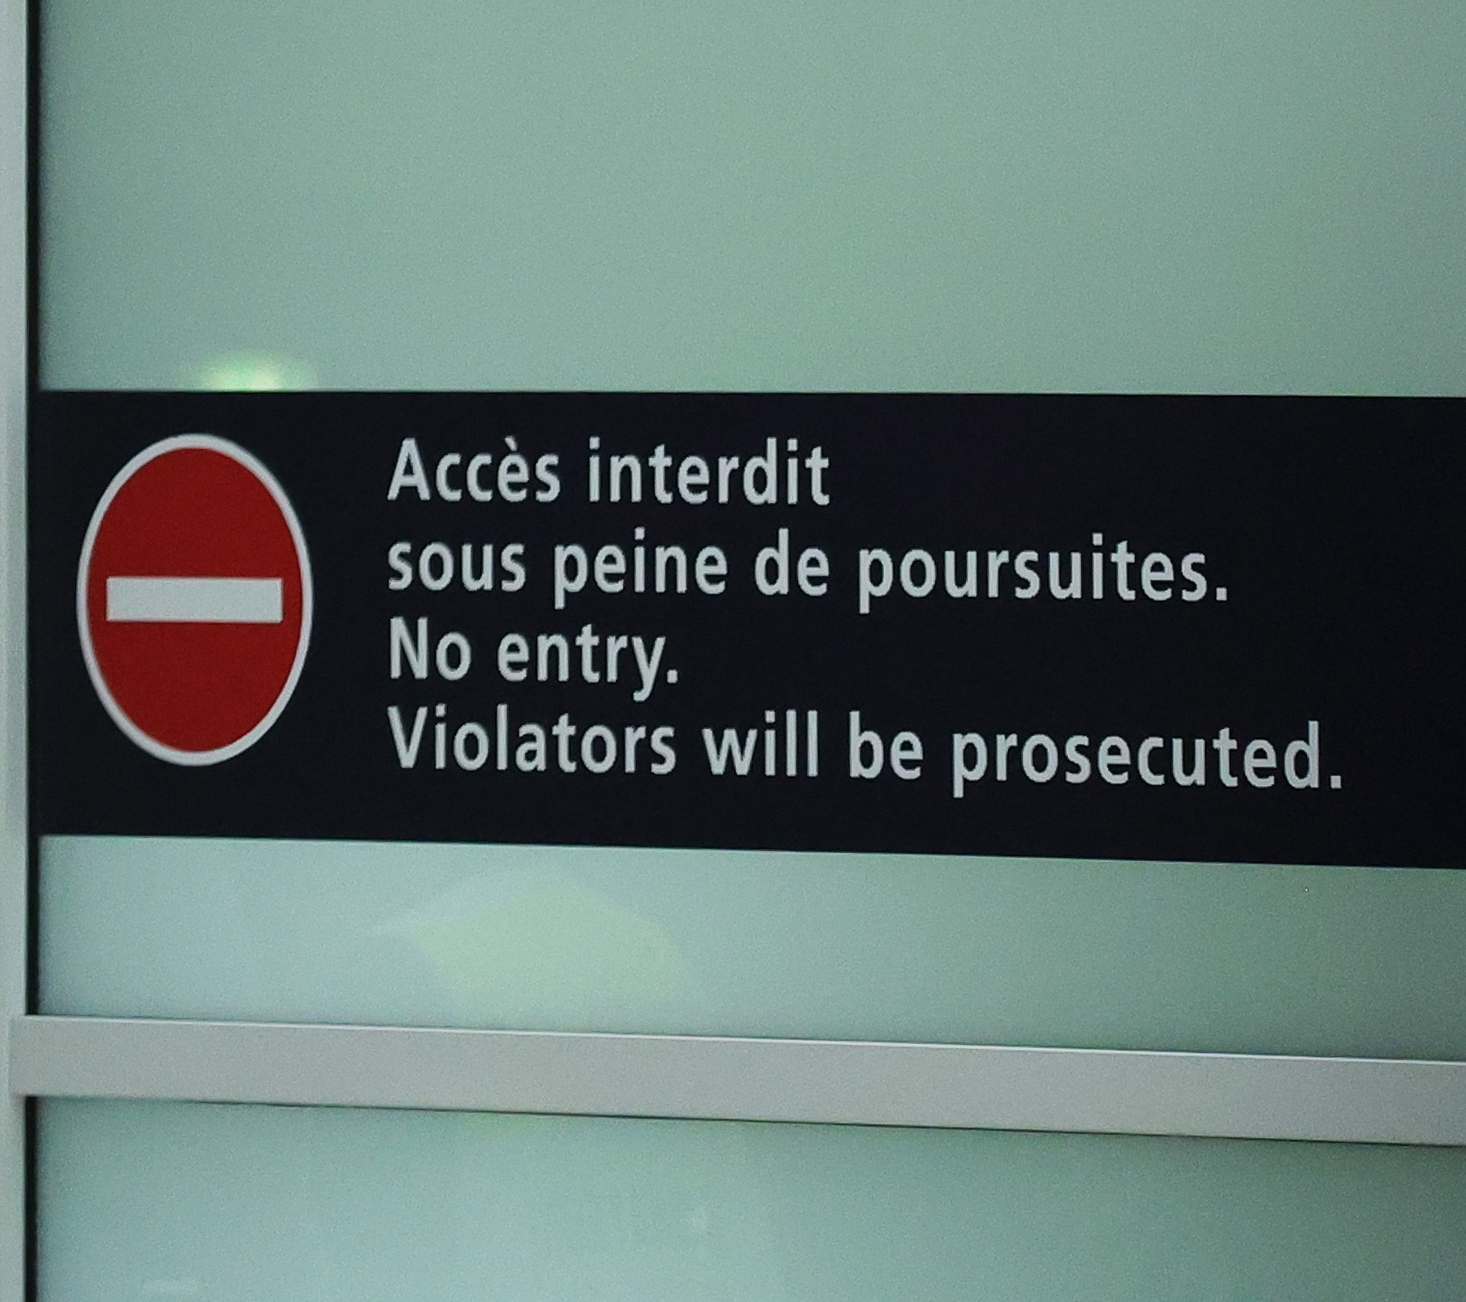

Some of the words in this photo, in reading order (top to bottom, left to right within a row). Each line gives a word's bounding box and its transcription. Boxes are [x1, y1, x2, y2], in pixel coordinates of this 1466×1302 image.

[386, 435, 562, 503] Accès
[588, 435, 831, 507] interdit
[387, 541, 527, 593] sous
[553, 525, 729, 611] peine
[753, 527, 831, 597] de
[858, 531, 1228, 615] poursuites.
[389, 615, 472, 682] No
[496, 622, 679, 703] entry.
[386, 702, 677, 776] Violators
[701, 708, 819, 778] will
[848, 709, 925, 781] be
[952, 719, 1343, 799] prosecuted.
